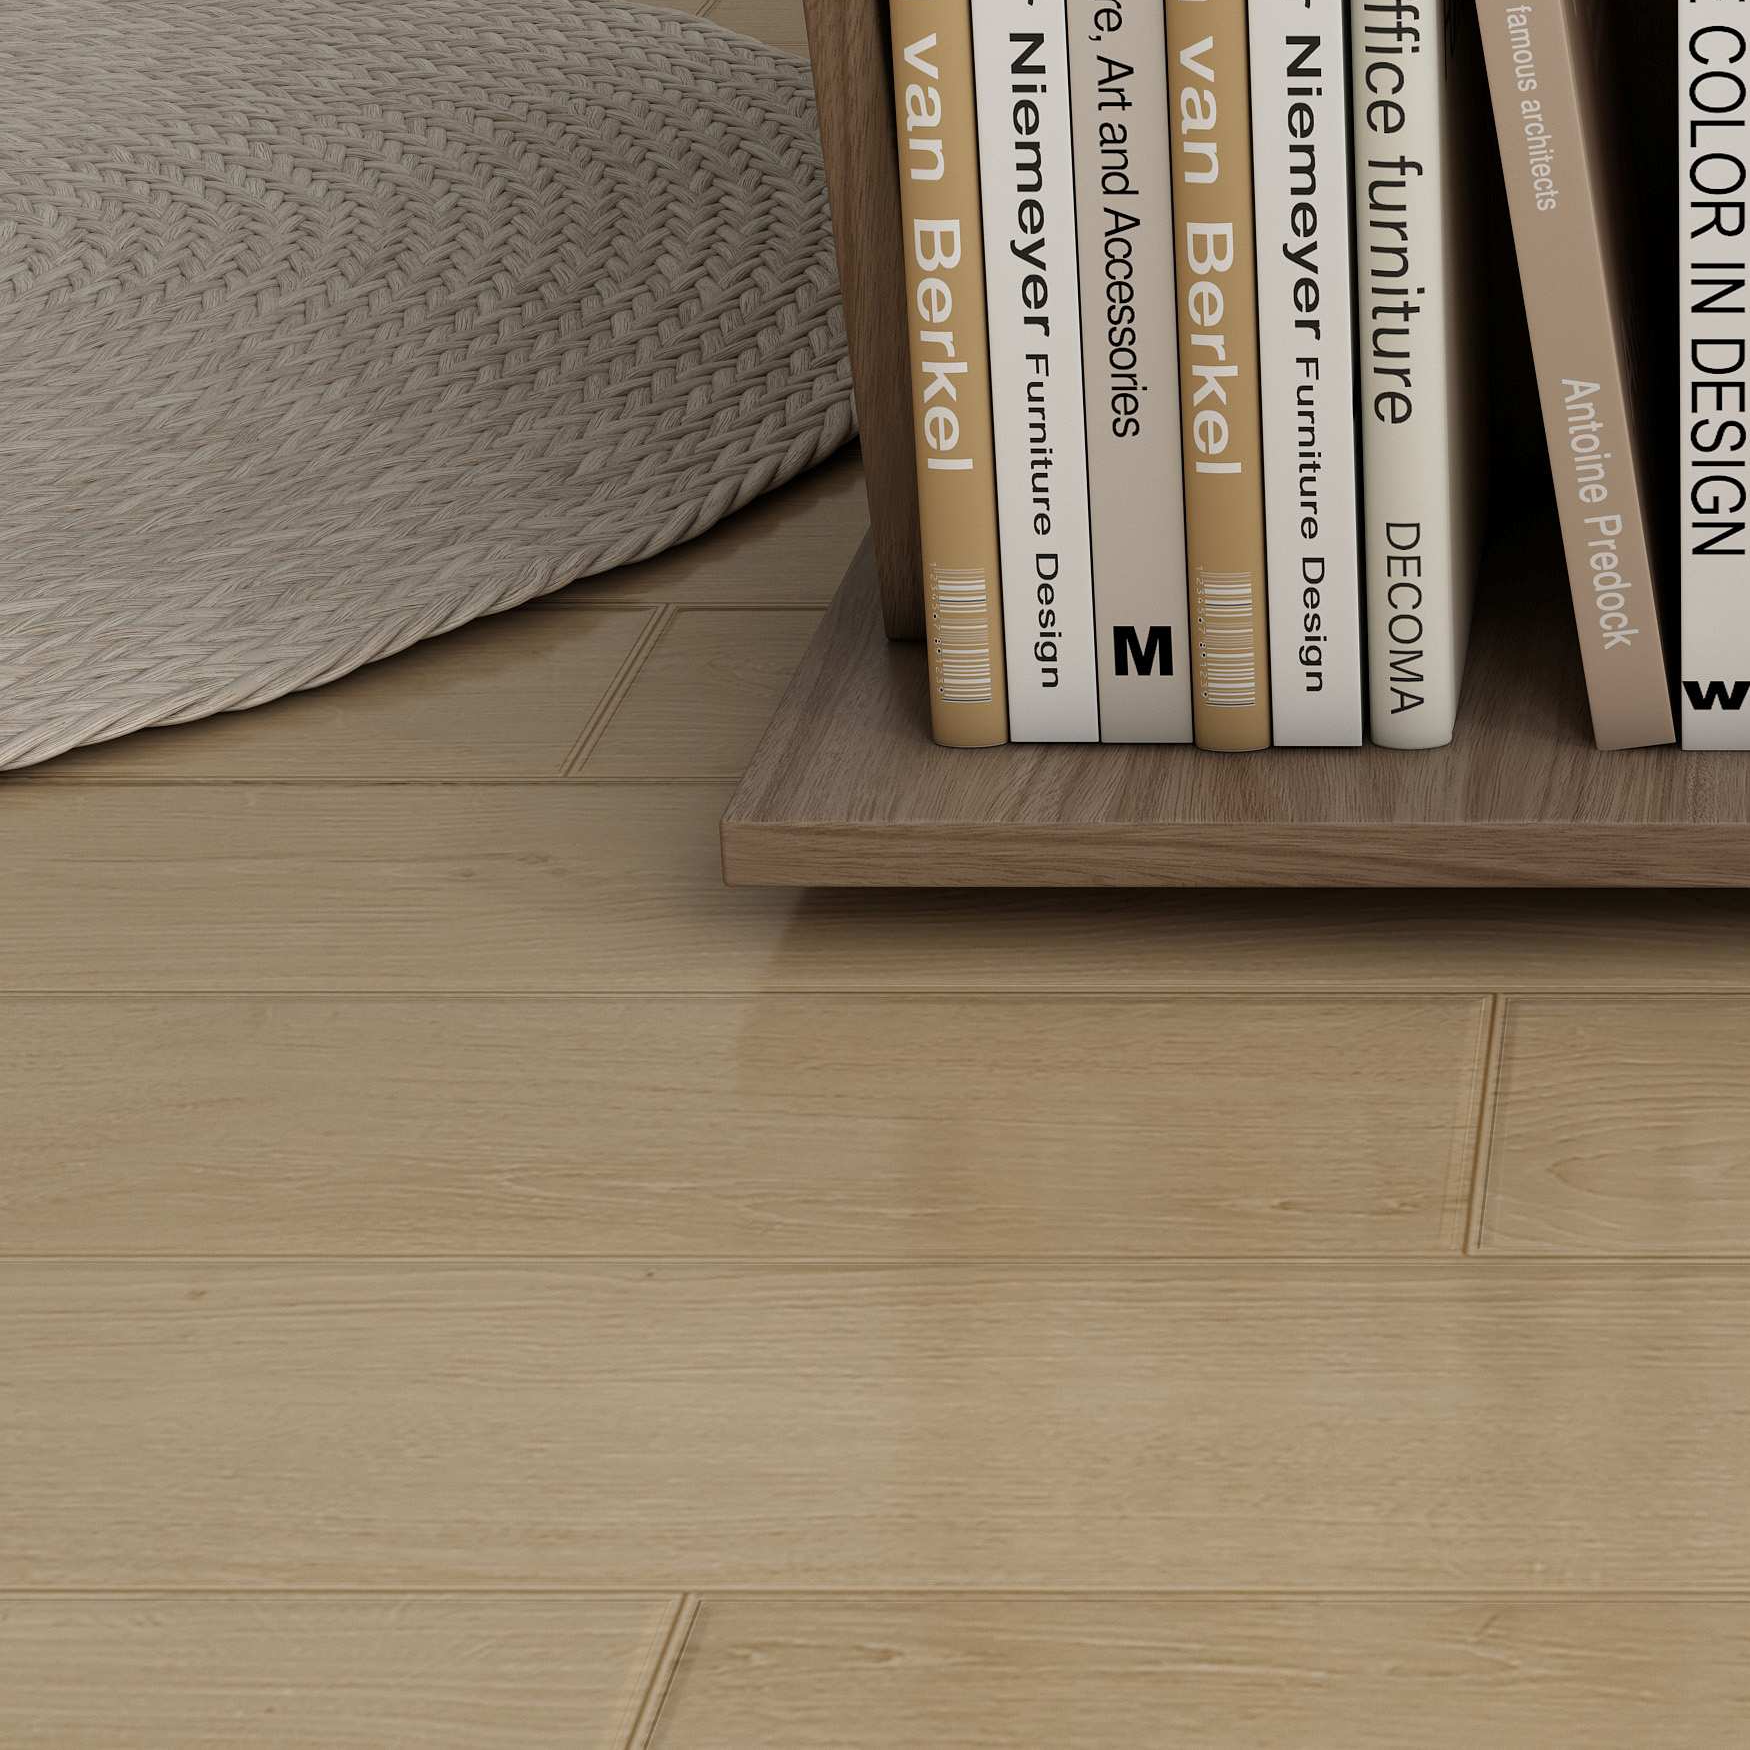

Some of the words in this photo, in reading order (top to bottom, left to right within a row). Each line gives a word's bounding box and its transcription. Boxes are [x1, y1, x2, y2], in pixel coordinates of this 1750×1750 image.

[903, 32, 945, 181] van
[1096, 54, 1135, 112] Art
[1179, 35, 1219, 184] van
[1505, 4, 1538, 92] famous
[1009, 32, 1050, 338] Niemeyer
[1098, 122, 1140, 195] and
[1282, 35, 1323, 341] Niemeyer
[1520, 99, 1559, 211] architects
[1688, 25, 1747, 239] COLOR
[913, 218, 974, 470] Berkel
[1103, 206, 1148, 438] Accessories
[1186, 222, 1242, 474] Berkel
[1366, 156, 1426, 426] furniture
[1690, 262, 1746, 314] IN
[1025, 353, 1053, 536] Furniture
[1295, 357, 1322, 540] Furniture
[1561, 378, 1612, 503] Antoine
[1690, 338, 1747, 555] DESIGN
[1033, 553, 1062, 688] Design
[1112, 625, 1174, 677] M
[1298, 557, 1328, 692] Design
[1385, 522, 1425, 715] DECOMA
[1583, 513, 1641, 650] Predock
